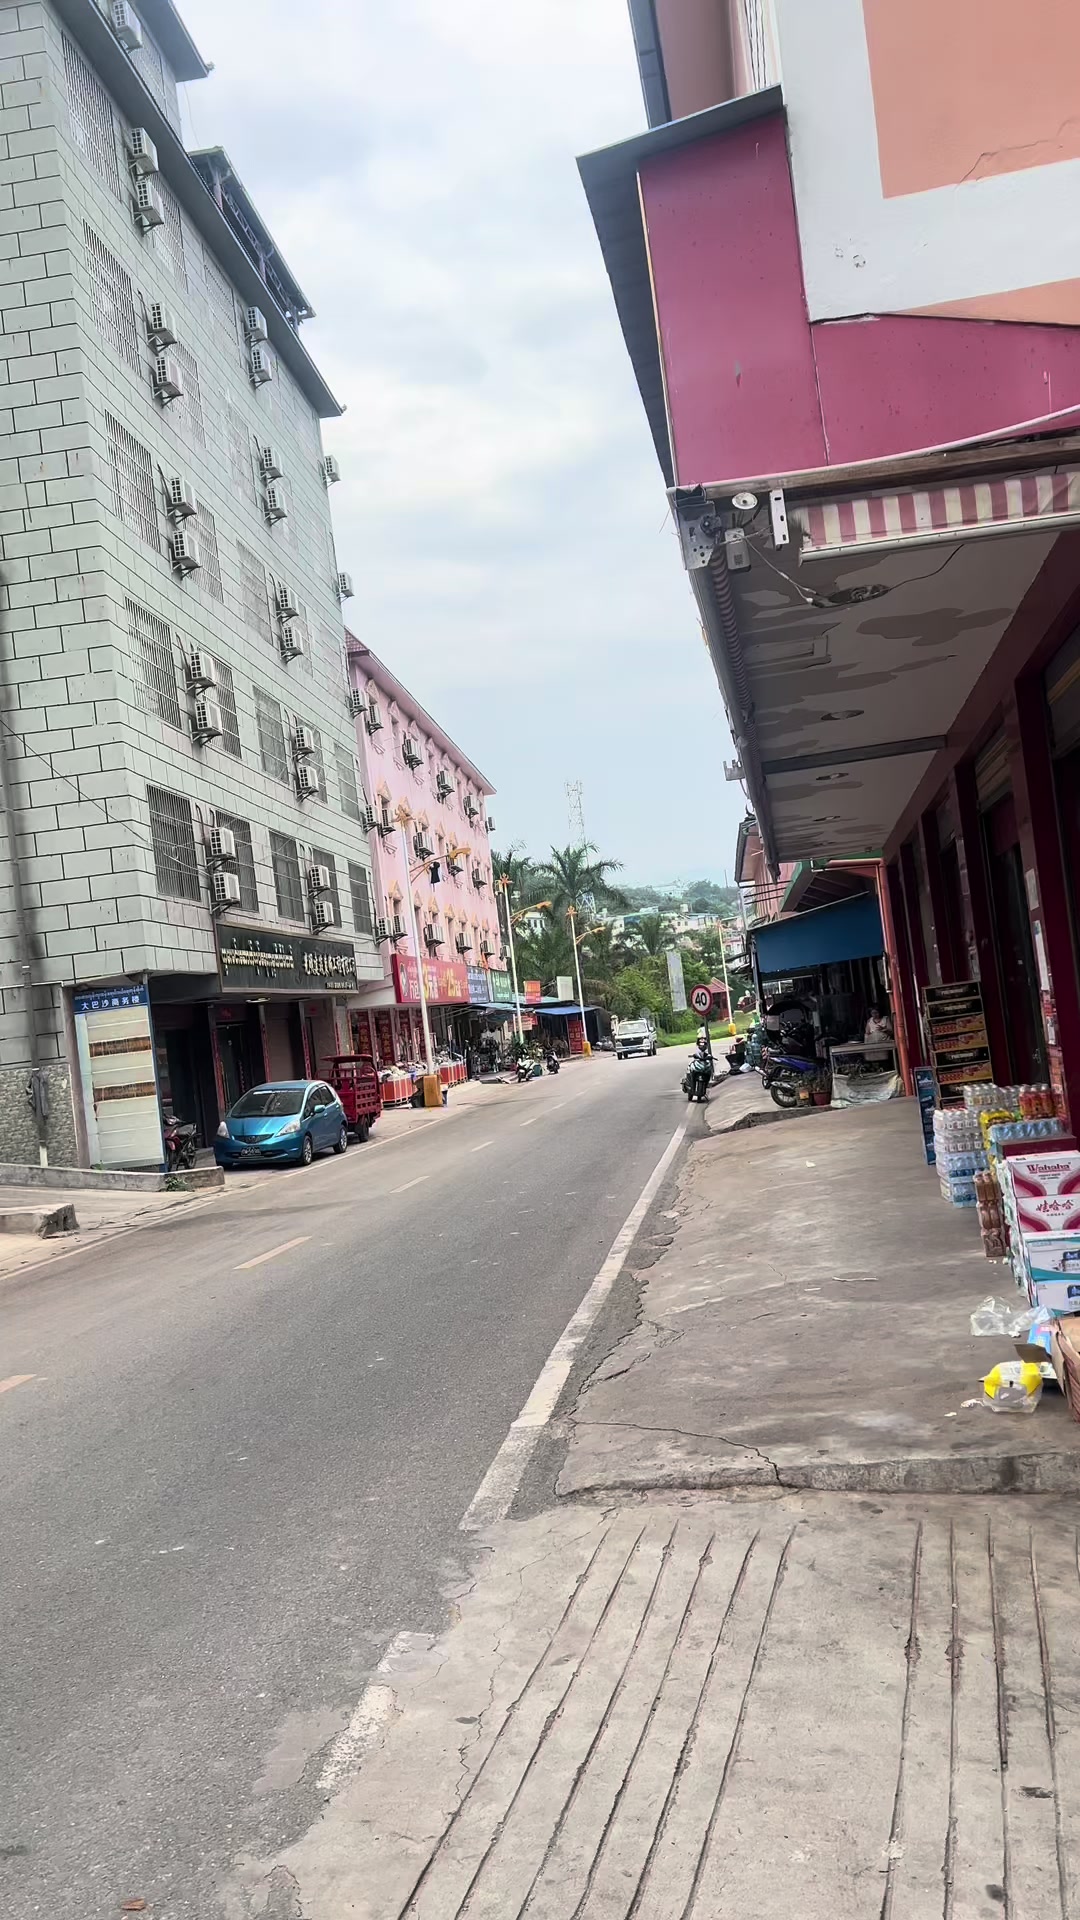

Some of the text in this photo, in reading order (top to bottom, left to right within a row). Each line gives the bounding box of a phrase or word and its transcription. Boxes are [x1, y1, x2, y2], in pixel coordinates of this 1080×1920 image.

[81, 995, 140, 1011] 大巴沙商务楼
[695, 992, 707, 1006] 40
[1026, 1163, 1071, 1173] Wahaha
[1036, 1200, 1073, 1213] 娃哈哈
